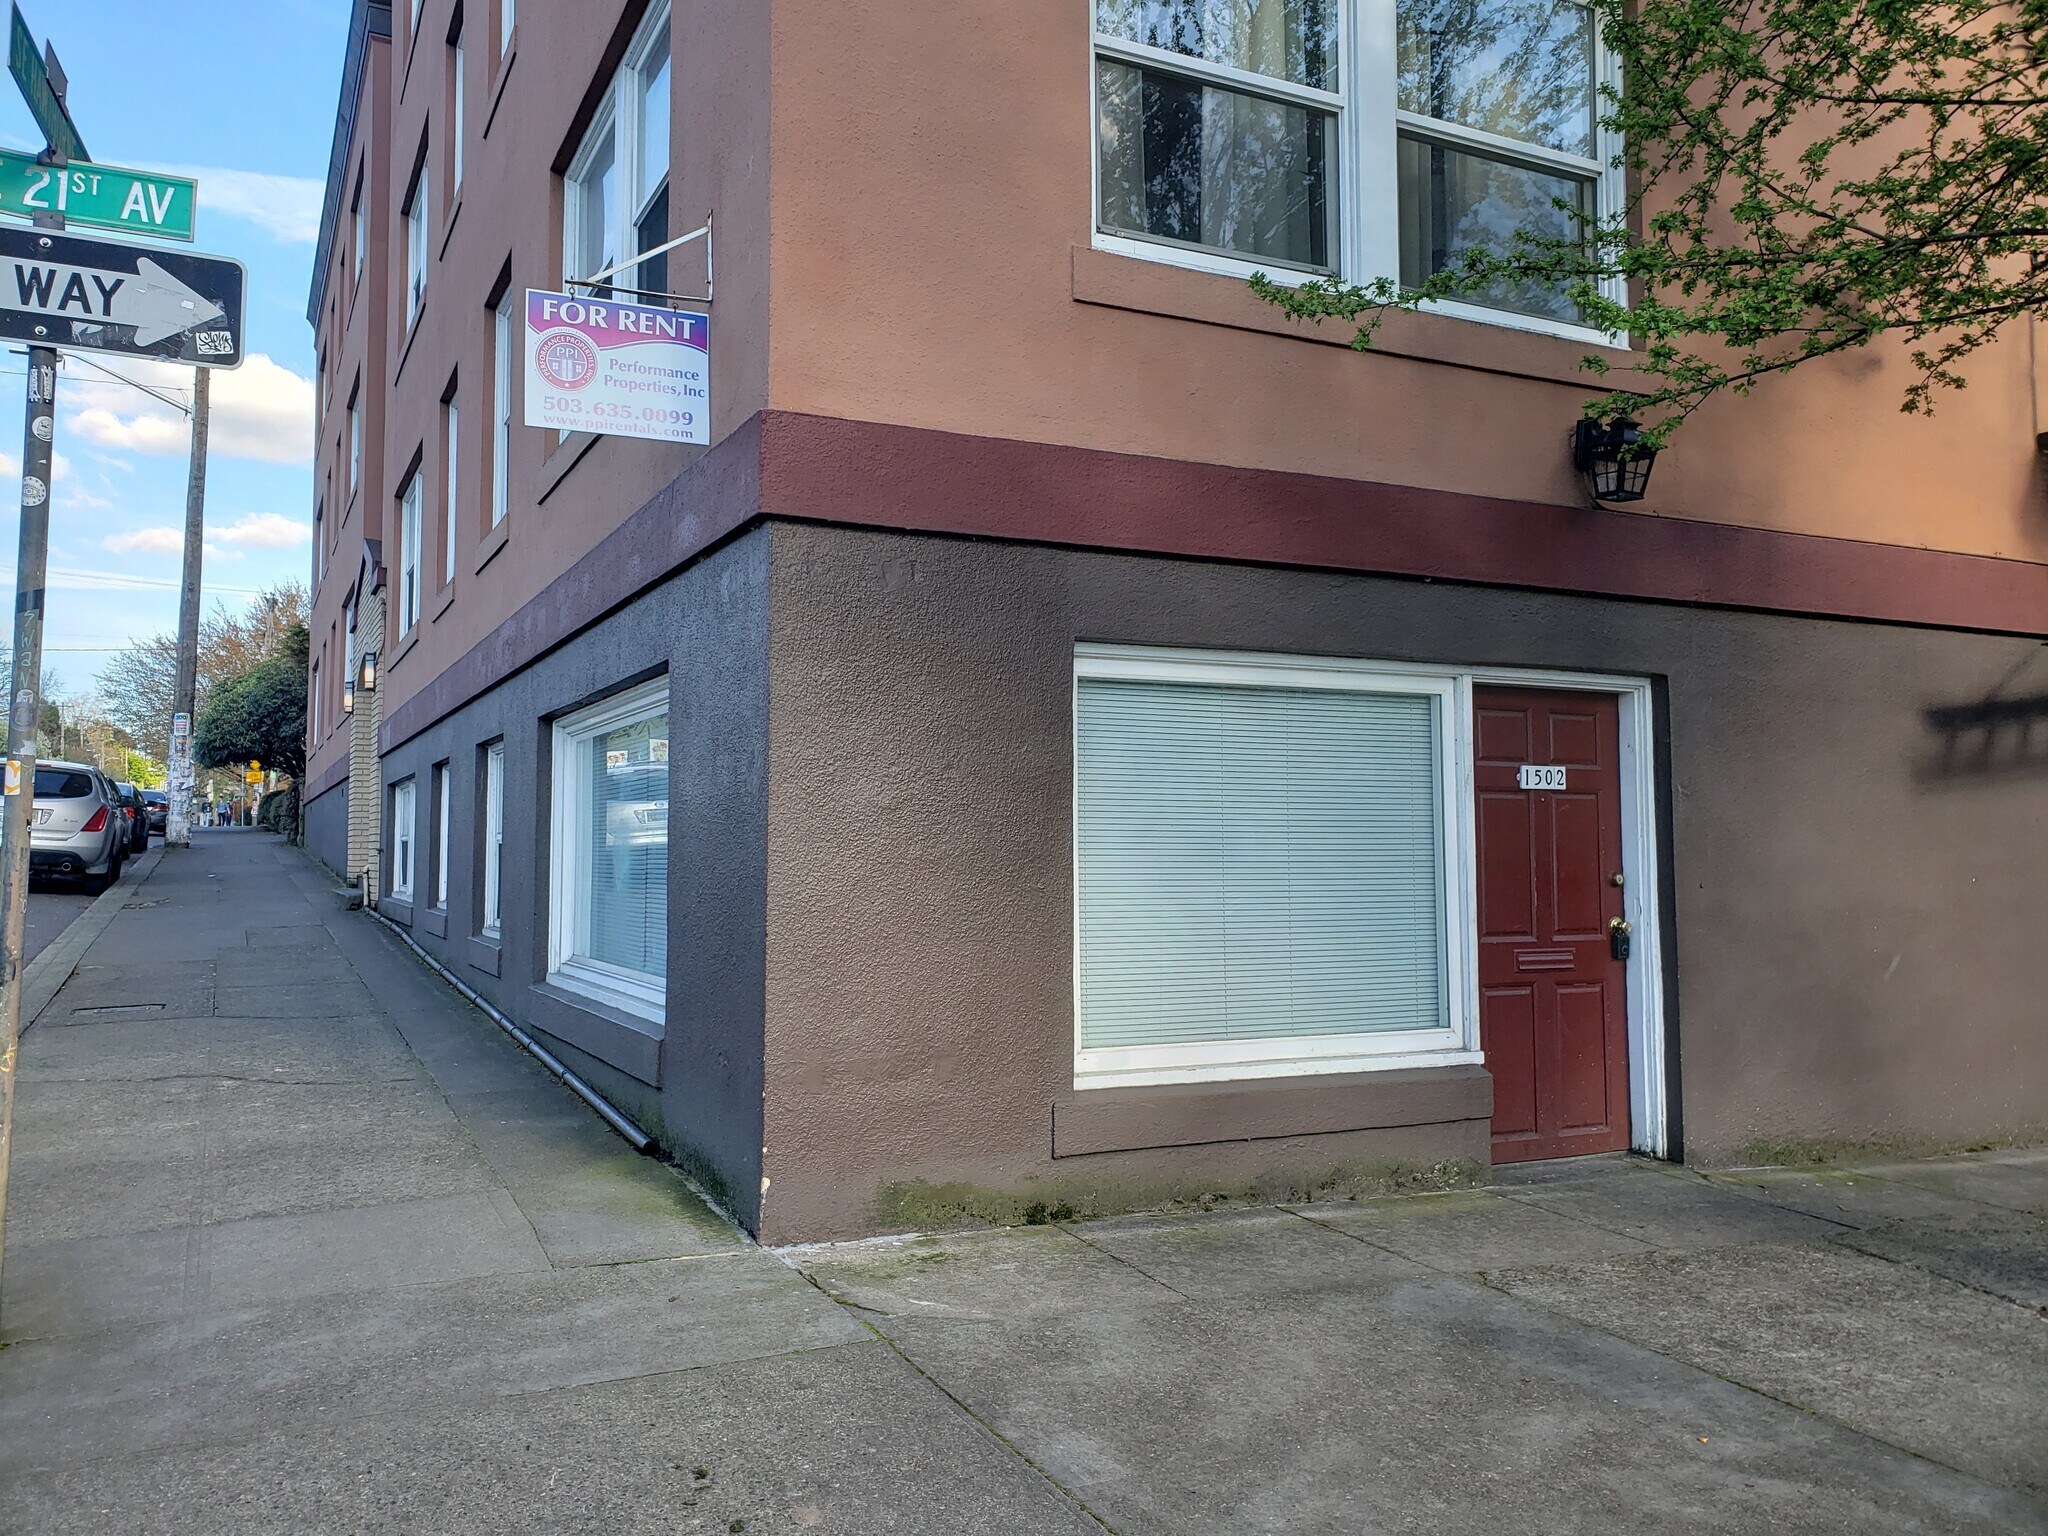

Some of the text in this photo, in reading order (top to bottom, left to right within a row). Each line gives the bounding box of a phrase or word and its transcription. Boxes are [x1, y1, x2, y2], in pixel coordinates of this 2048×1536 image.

[16, 25, 28, 83] SE
[120, 181, 175, 225] AV
[14, 263, 126, 317] WAY
[542, 298, 696, 340] FOR RENT
[539, 336, 565, 377] PERFORMANCE
[556, 346, 578, 359] PPI
[609, 358, 700, 381] Performance
[604, 374, 681, 398] Properties,
[683, 384, 705, 399] Inc
[543, 395, 694, 426] 503.635.0099
[543, 415, 694, 439] www.ppirentals.com
[1523, 768, 1565, 786] 1502
